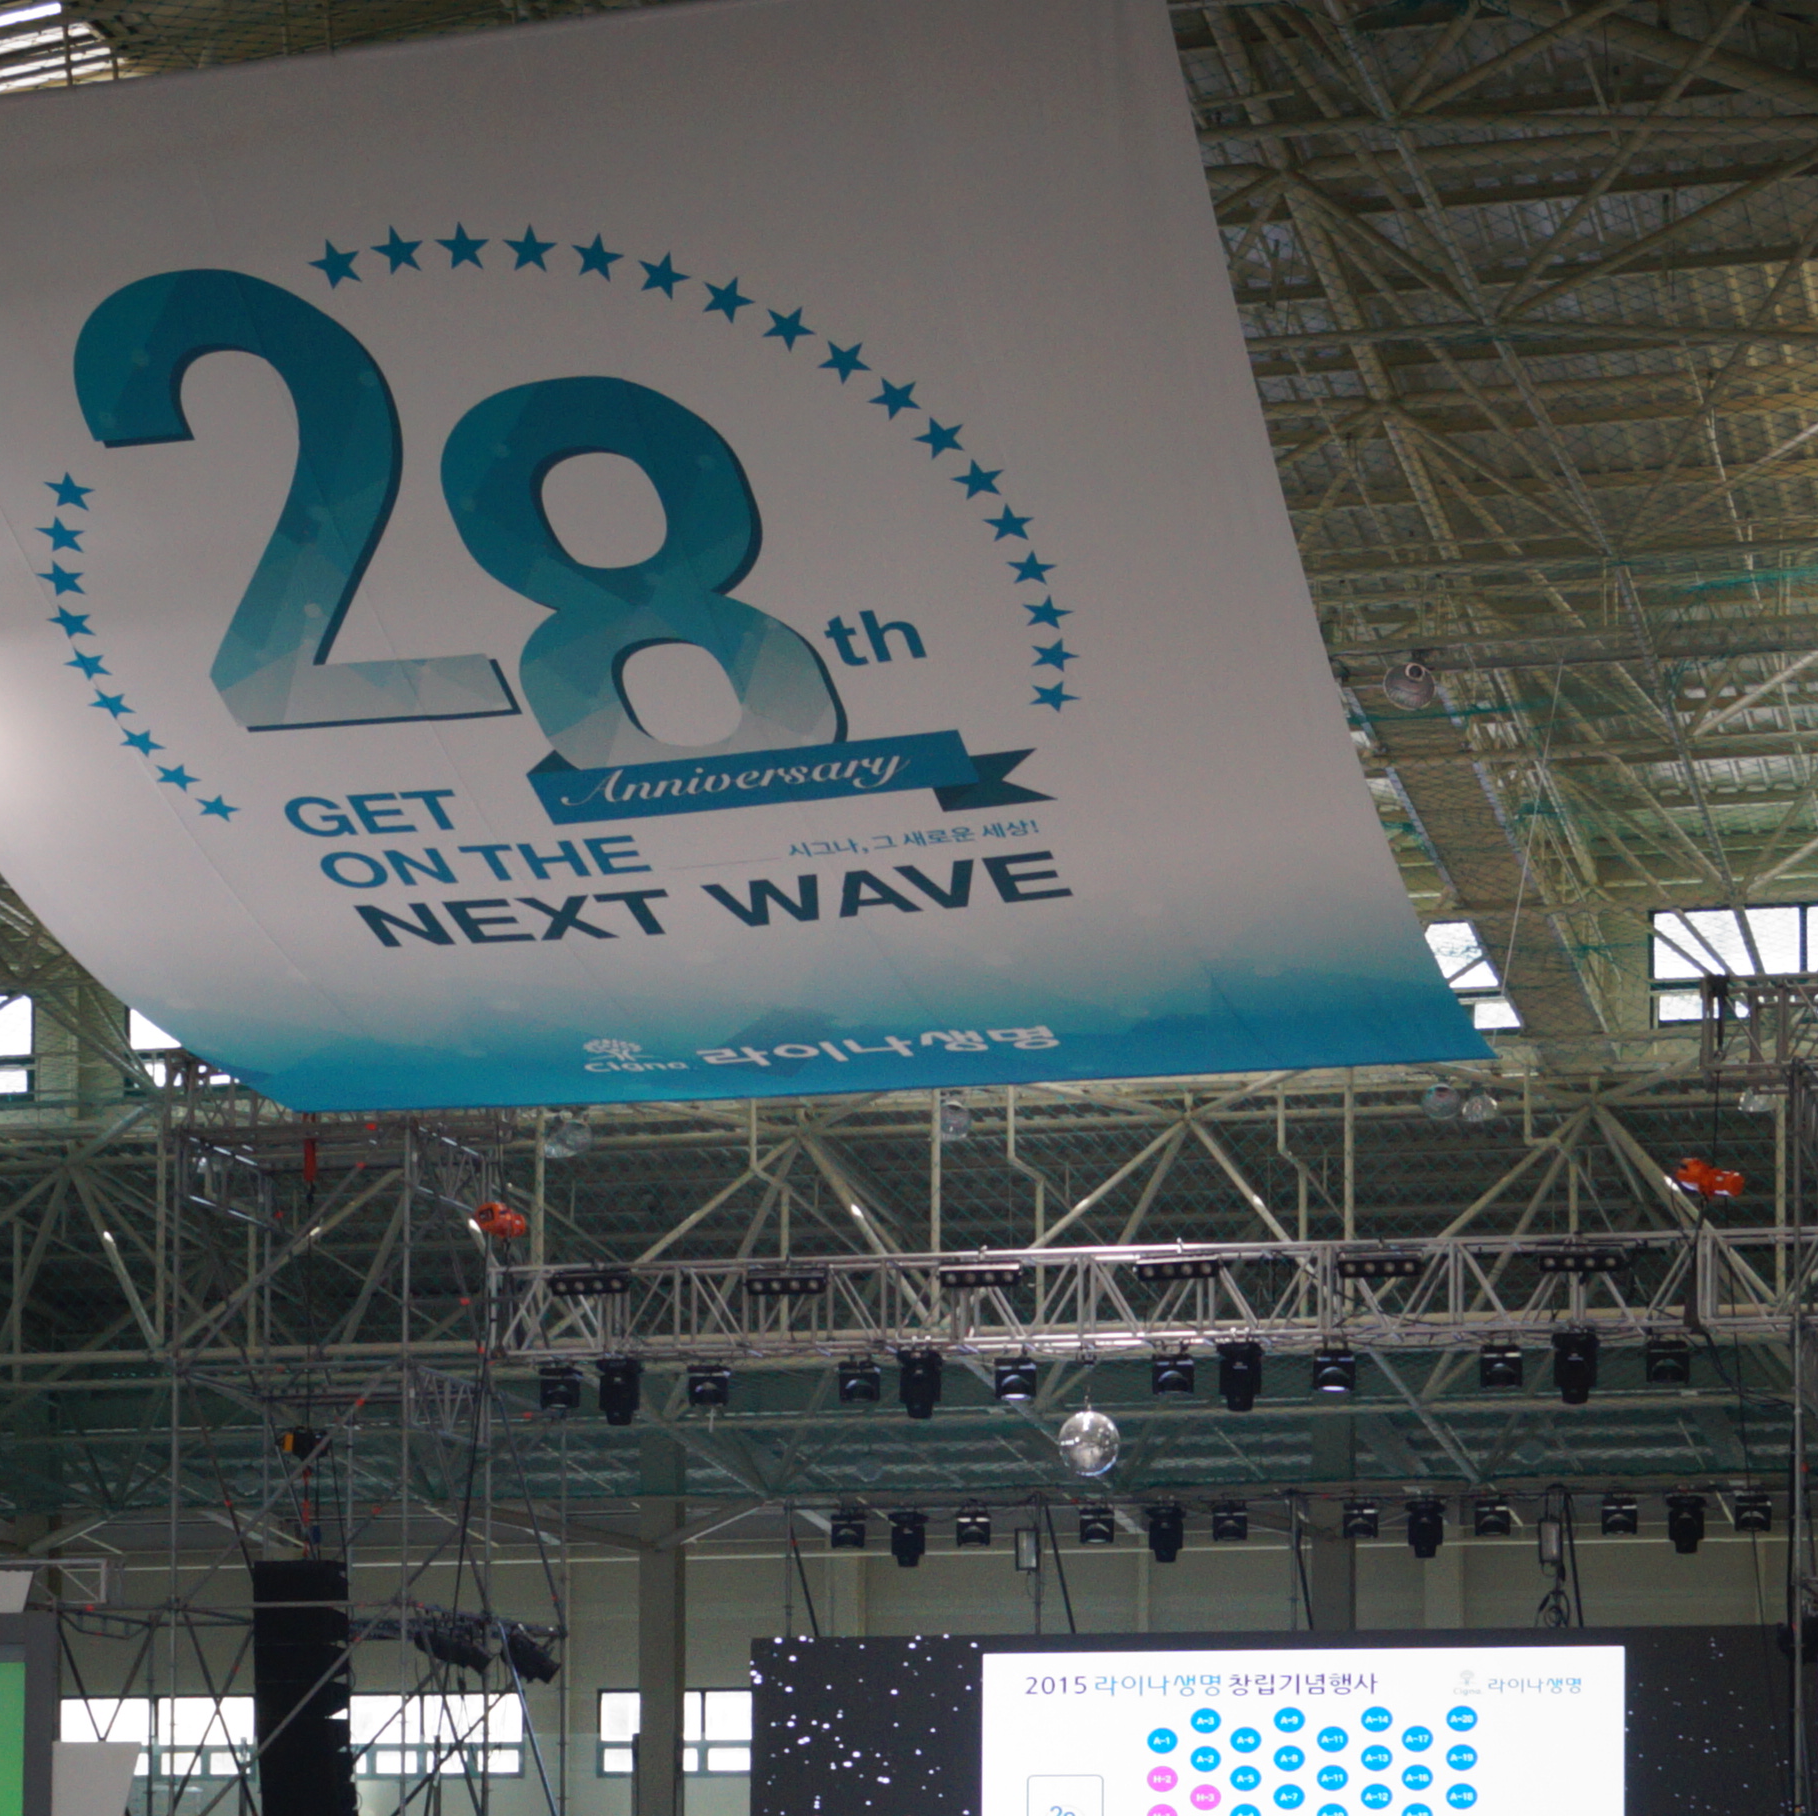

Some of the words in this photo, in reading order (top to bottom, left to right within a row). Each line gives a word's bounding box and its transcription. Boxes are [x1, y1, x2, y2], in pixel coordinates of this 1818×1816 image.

[559, 750, 913, 808] Anniversary
[282, 788, 456, 838] GET
[895, 825, 976, 849] 새로운
[980, 818, 1040, 842] 세상!
[319, 848, 458, 890] ON
[457, 834, 653, 887] THE
[354, 888, 670, 949] NEXT
[701, 850, 1074, 928] WAVE
[695, 1024, 1062, 1070] 라이나생명
[1024, 1675, 1088, 1696] 2015
[1093, 1674, 1222, 1697] 라이나생명
[1228, 1673, 1379, 1696] 창립기념행사
[1487, 1676, 1582, 1695] 라이나생명
